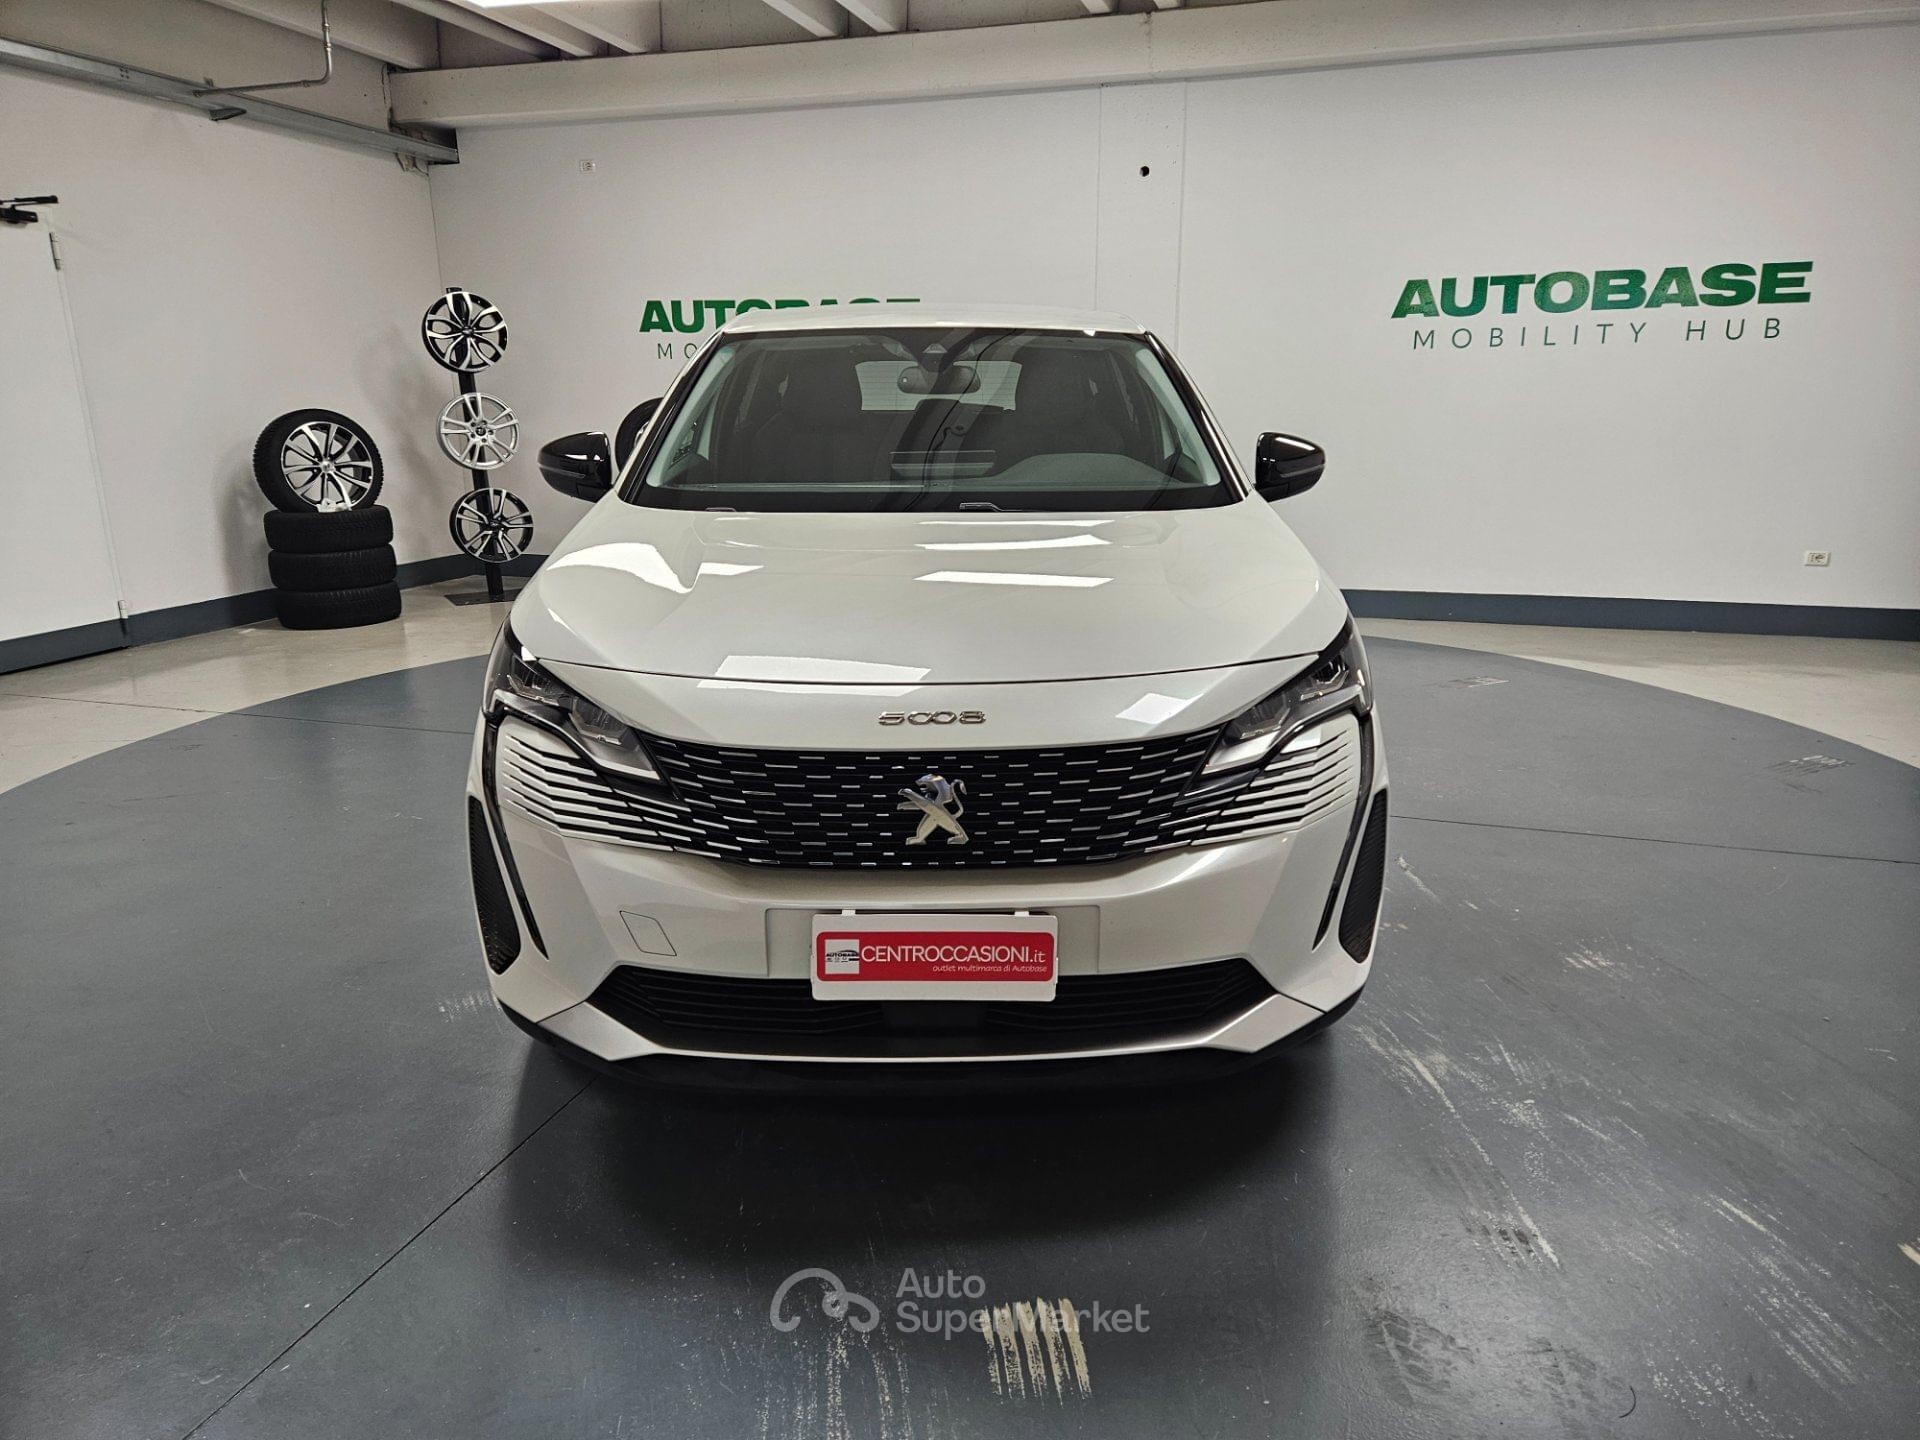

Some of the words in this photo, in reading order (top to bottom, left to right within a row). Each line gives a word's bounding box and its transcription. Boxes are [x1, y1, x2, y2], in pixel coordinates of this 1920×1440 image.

[1391, 261, 1813, 318] AUTOBASE
[1413, 322, 1647, 350] MOBILITY
[1685, 317, 1781, 342] HUB
[878, 710, 986, 726] 5008
[861, 945, 1047, 963] CENTROCCASIONI.it
[932, 964, 956, 972] outlet
[957, 964, 1002, 972] multimarca
[1003, 964, 1011, 973] di
[1012, 964, 1048, 973] Autobase
